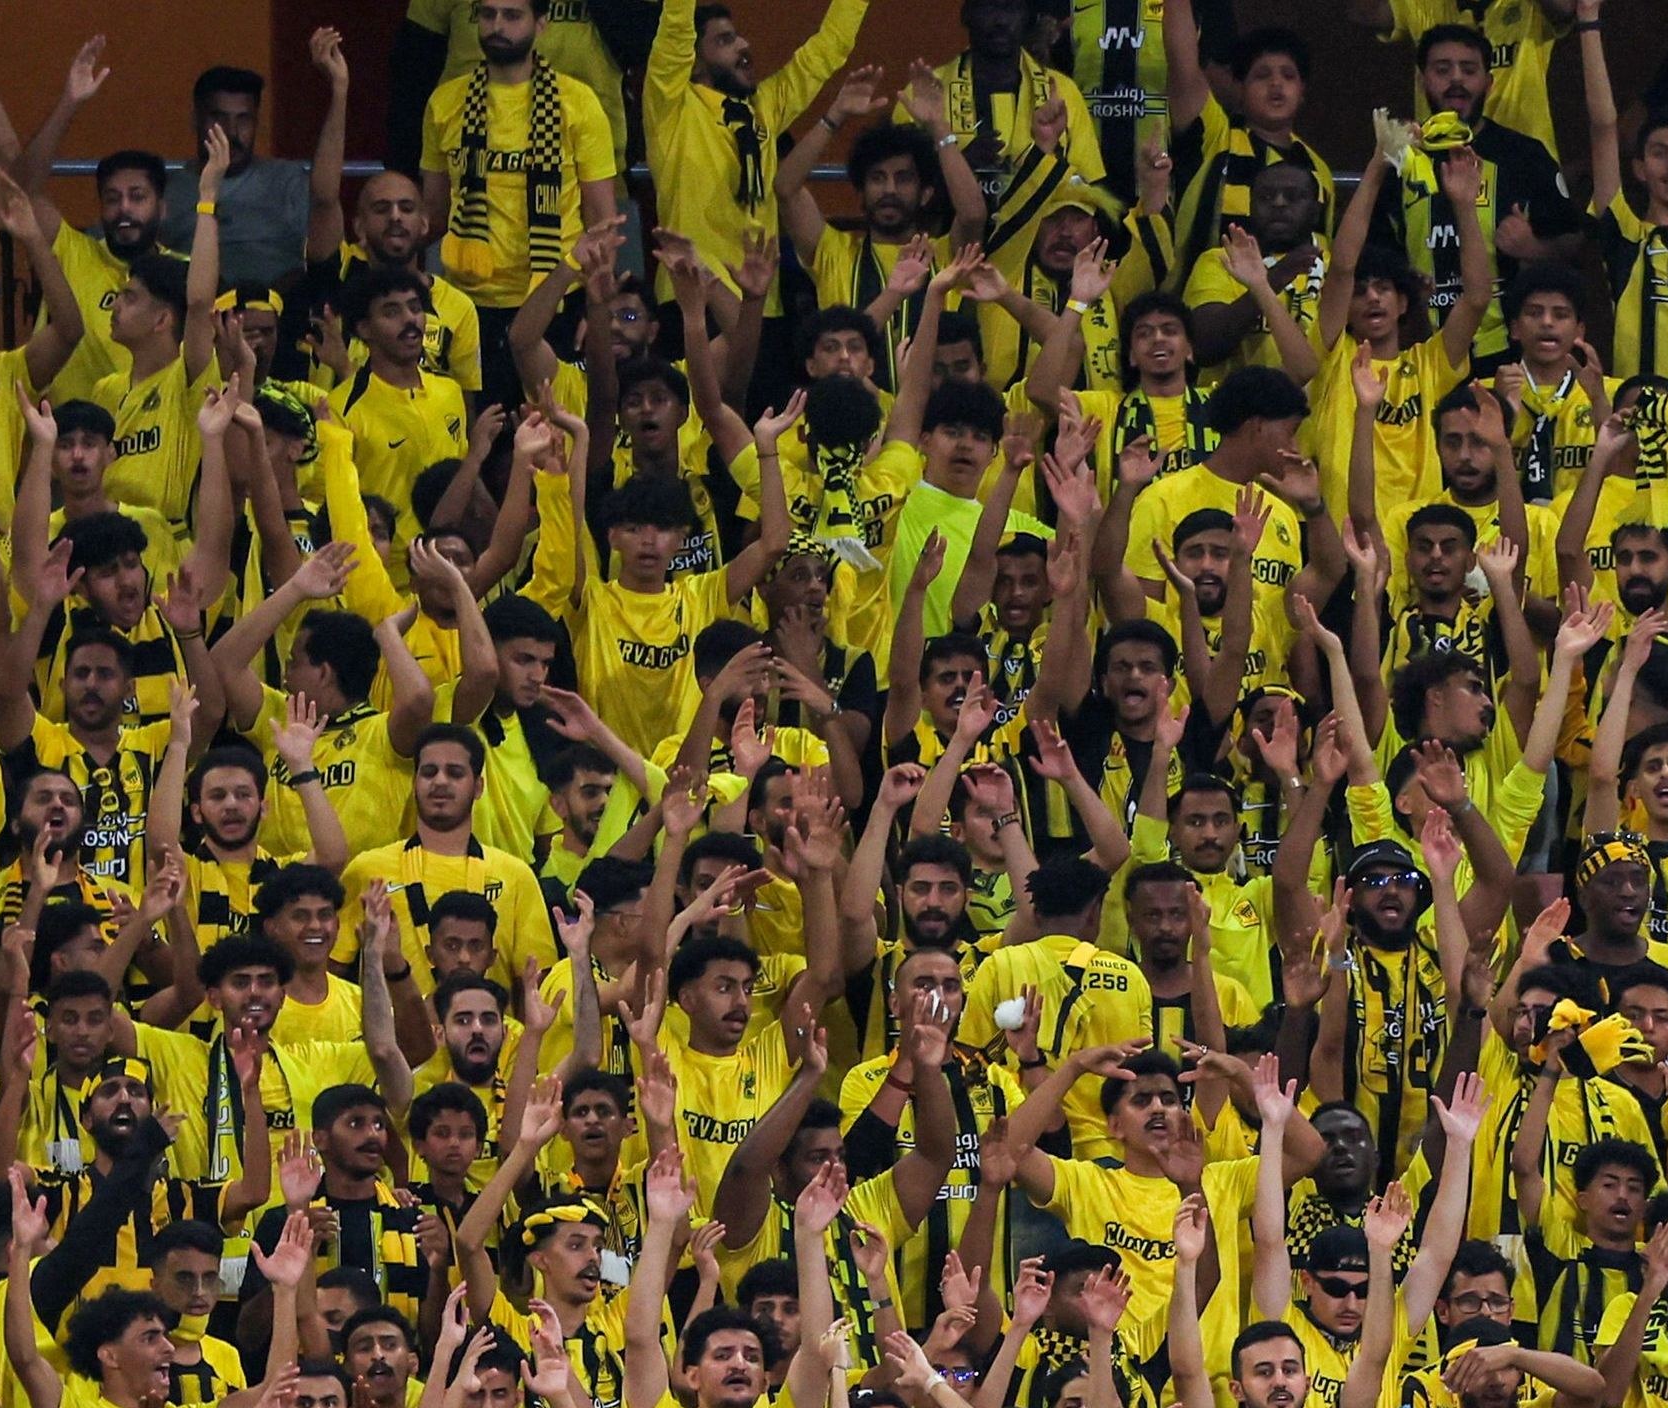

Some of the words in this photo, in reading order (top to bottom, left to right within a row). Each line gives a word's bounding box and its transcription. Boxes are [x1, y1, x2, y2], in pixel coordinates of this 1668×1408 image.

[1093, 105, 1145, 118] ROSHN
[1431, 289, 1458, 307] ROS
[119, 428, 160, 457] OLD
[621, 642, 655, 669] RVA
[83, 828, 130, 847] OSHN
[685, 1113, 723, 1142] RVA
